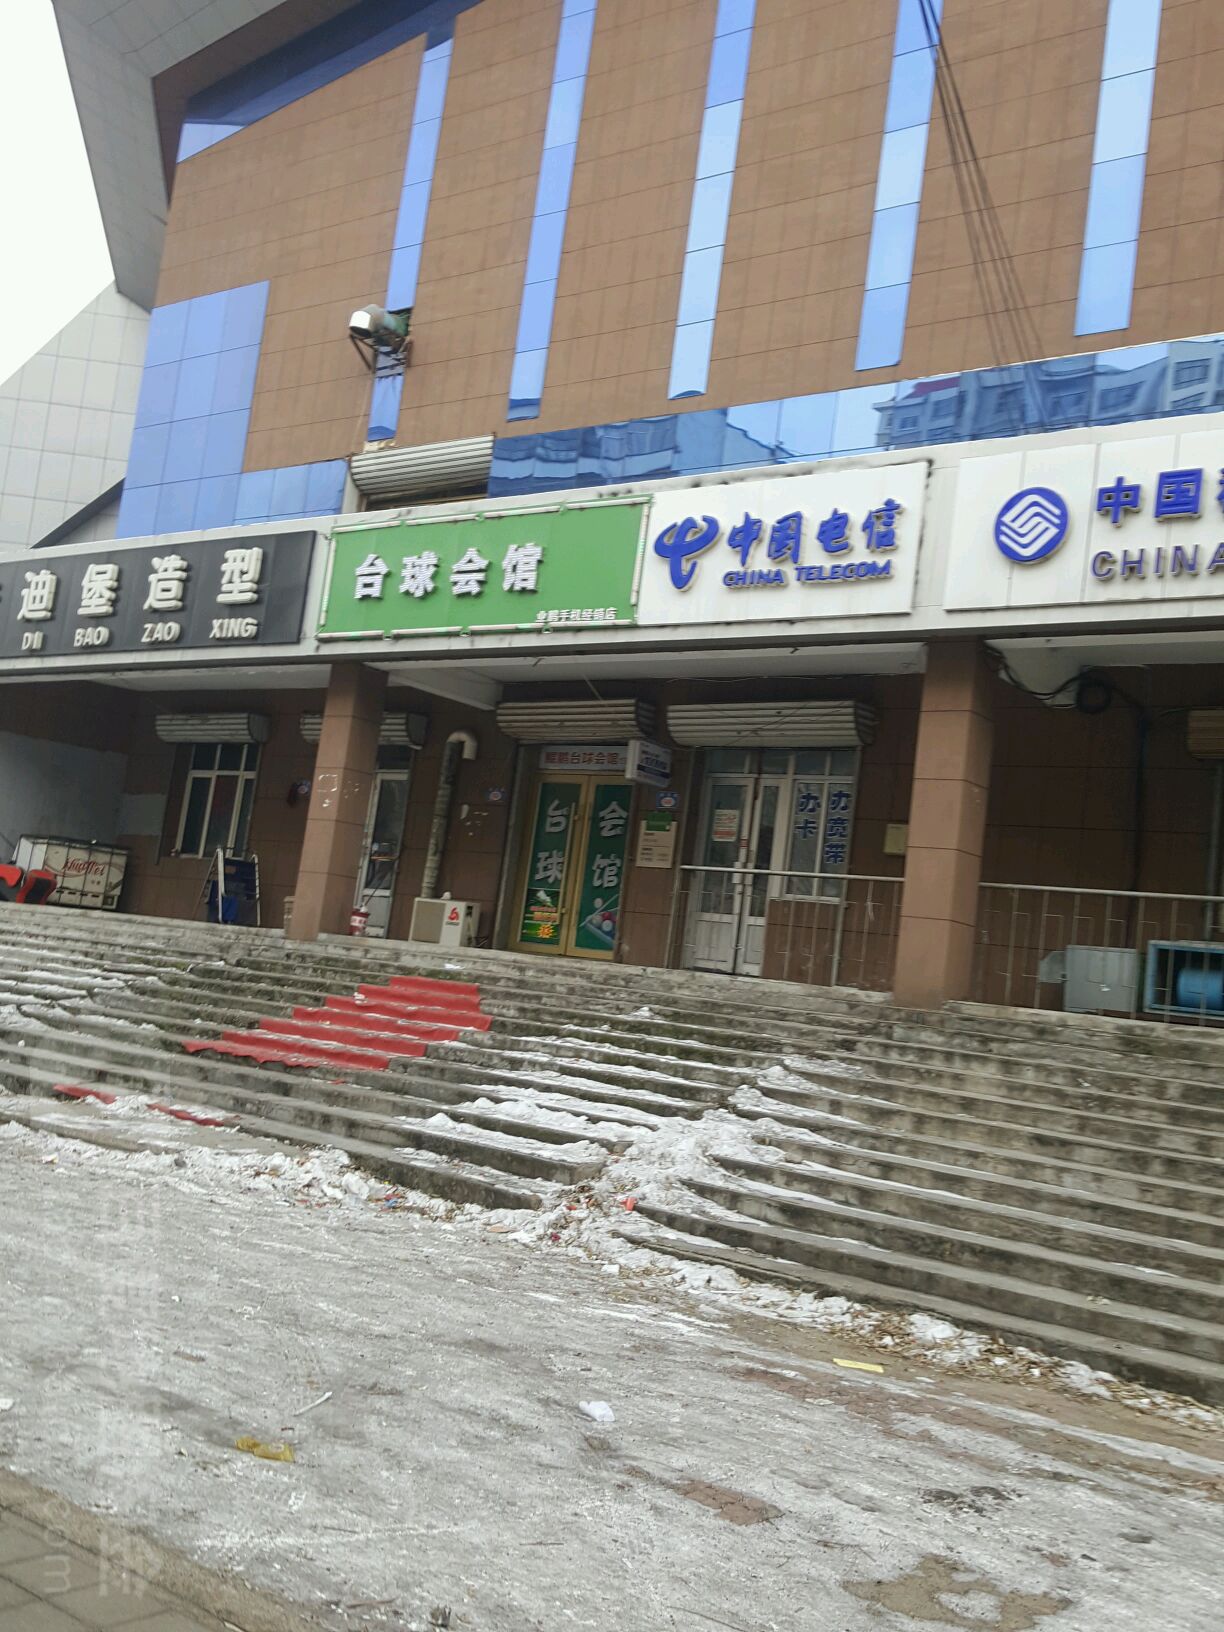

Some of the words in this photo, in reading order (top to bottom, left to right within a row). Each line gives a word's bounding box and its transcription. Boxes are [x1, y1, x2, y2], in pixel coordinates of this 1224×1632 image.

[1096, 467, 1224, 524] 中国
[727, 498, 901, 567] 中国电信
[1091, 543, 1224, 579] CHINA
[17, 547, 263, 621] 迪堡造型
[354, 542, 544, 600] 台球会馆
[722, 568, 787, 589] CHINA
[795, 559, 894, 583] TELECOM
[22, 631, 44, 650] DI
[73, 626, 110, 648] BAO
[141, 621, 181, 643] ZAO
[209, 617, 258, 640] XING
[535, 799, 569, 883] 台球
[592, 801, 628, 888] 会馆
[795, 792, 820, 839] 办卡
[824, 790, 852, 864] 办宽带
